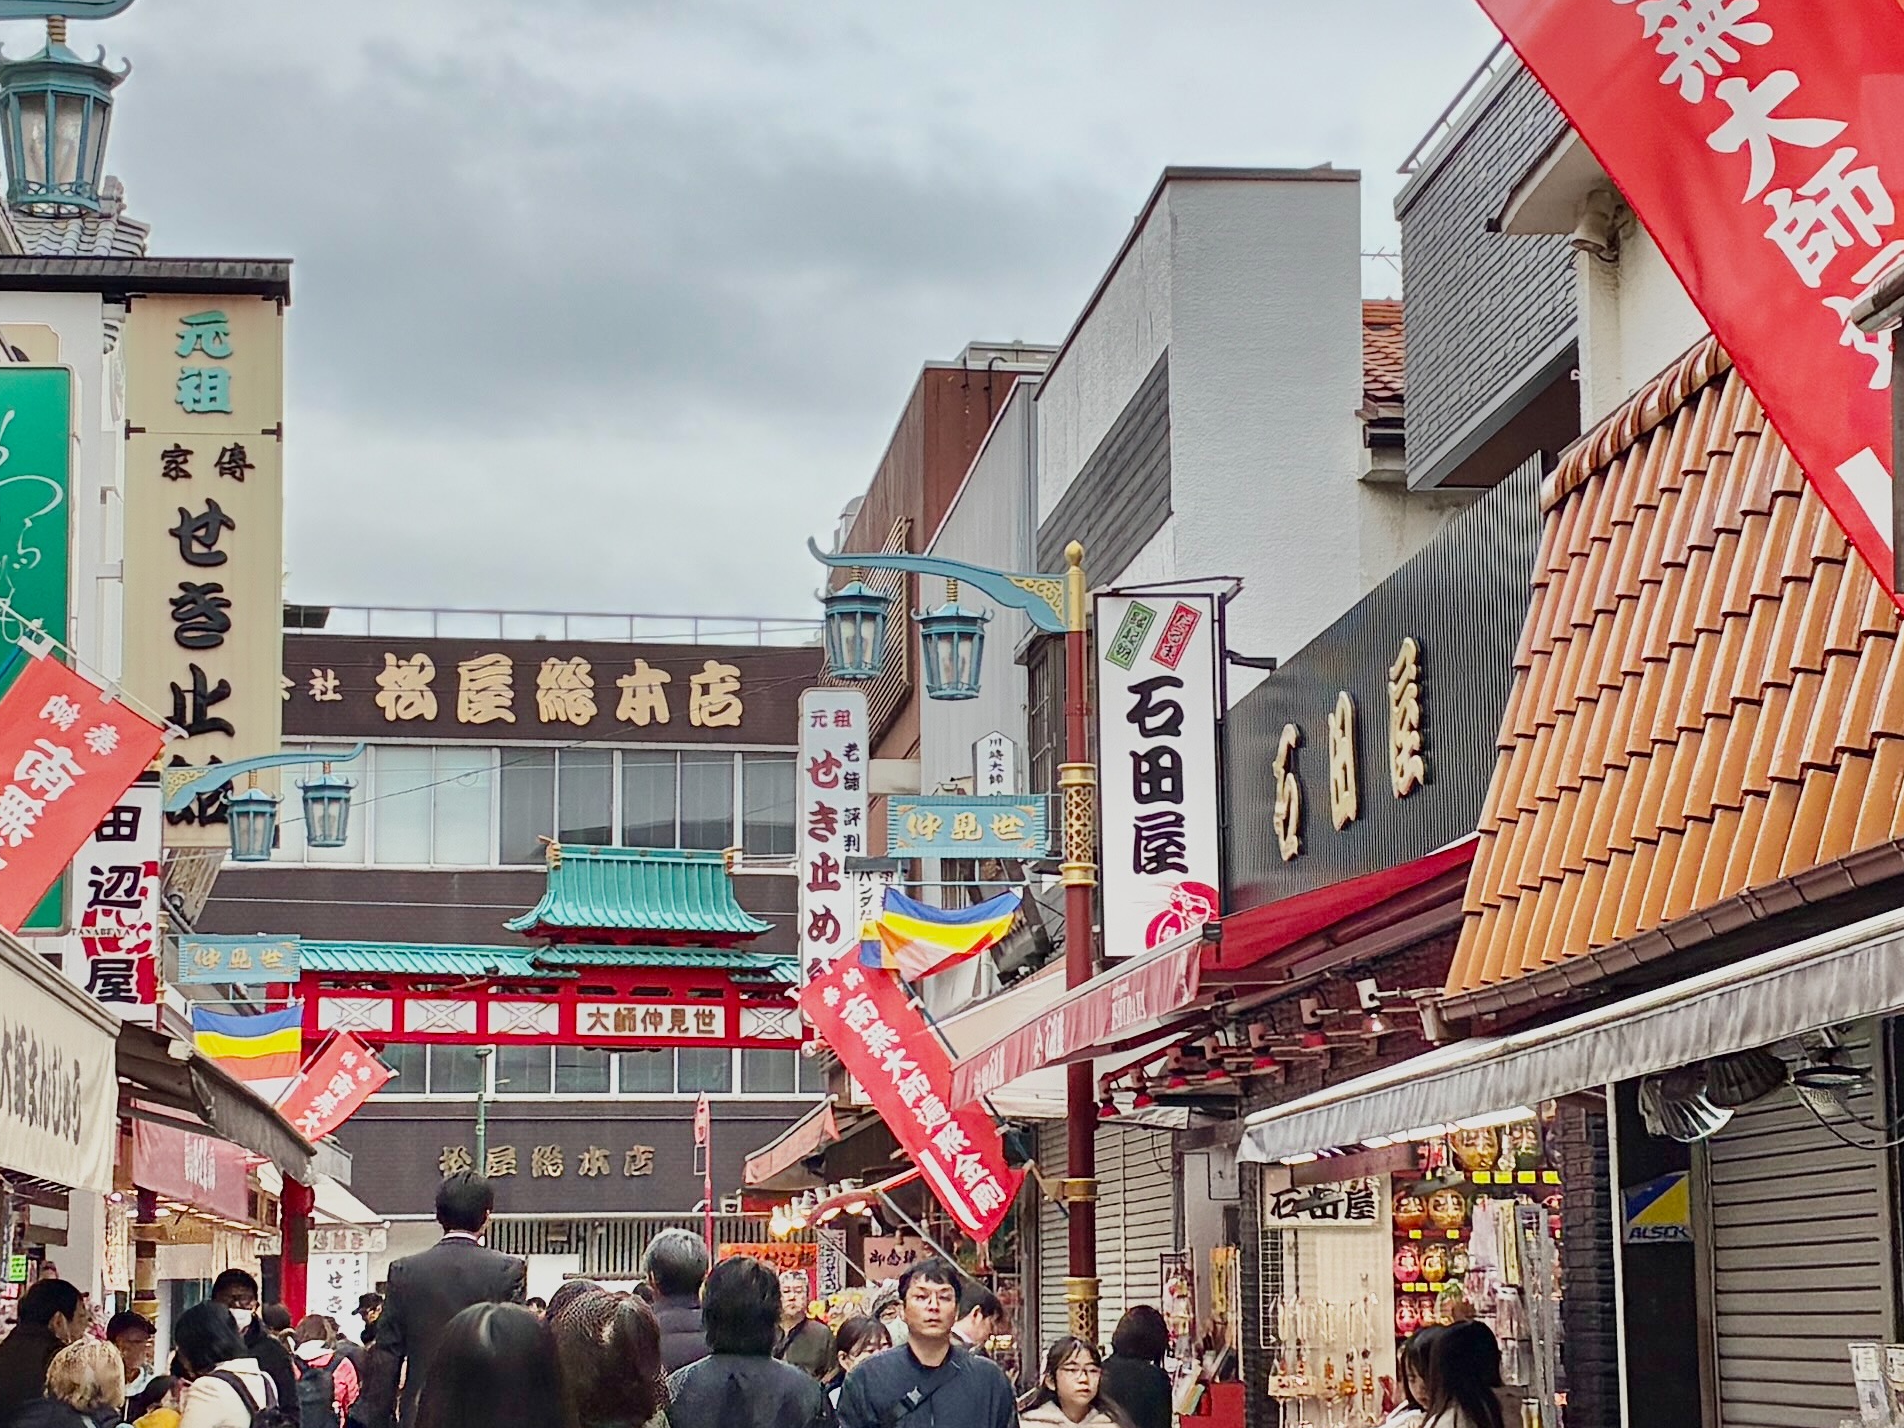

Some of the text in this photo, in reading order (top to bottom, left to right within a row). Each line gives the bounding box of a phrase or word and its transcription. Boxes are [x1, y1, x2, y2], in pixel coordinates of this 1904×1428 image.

[174, 309, 235, 415] 元祖
[1125, 674, 1190, 876] 石田屋
[905, 811, 1026, 842] 仲見世
[192, 946, 284, 971] 仲見世
[586, 1005, 717, 1036] 大師仲見世
